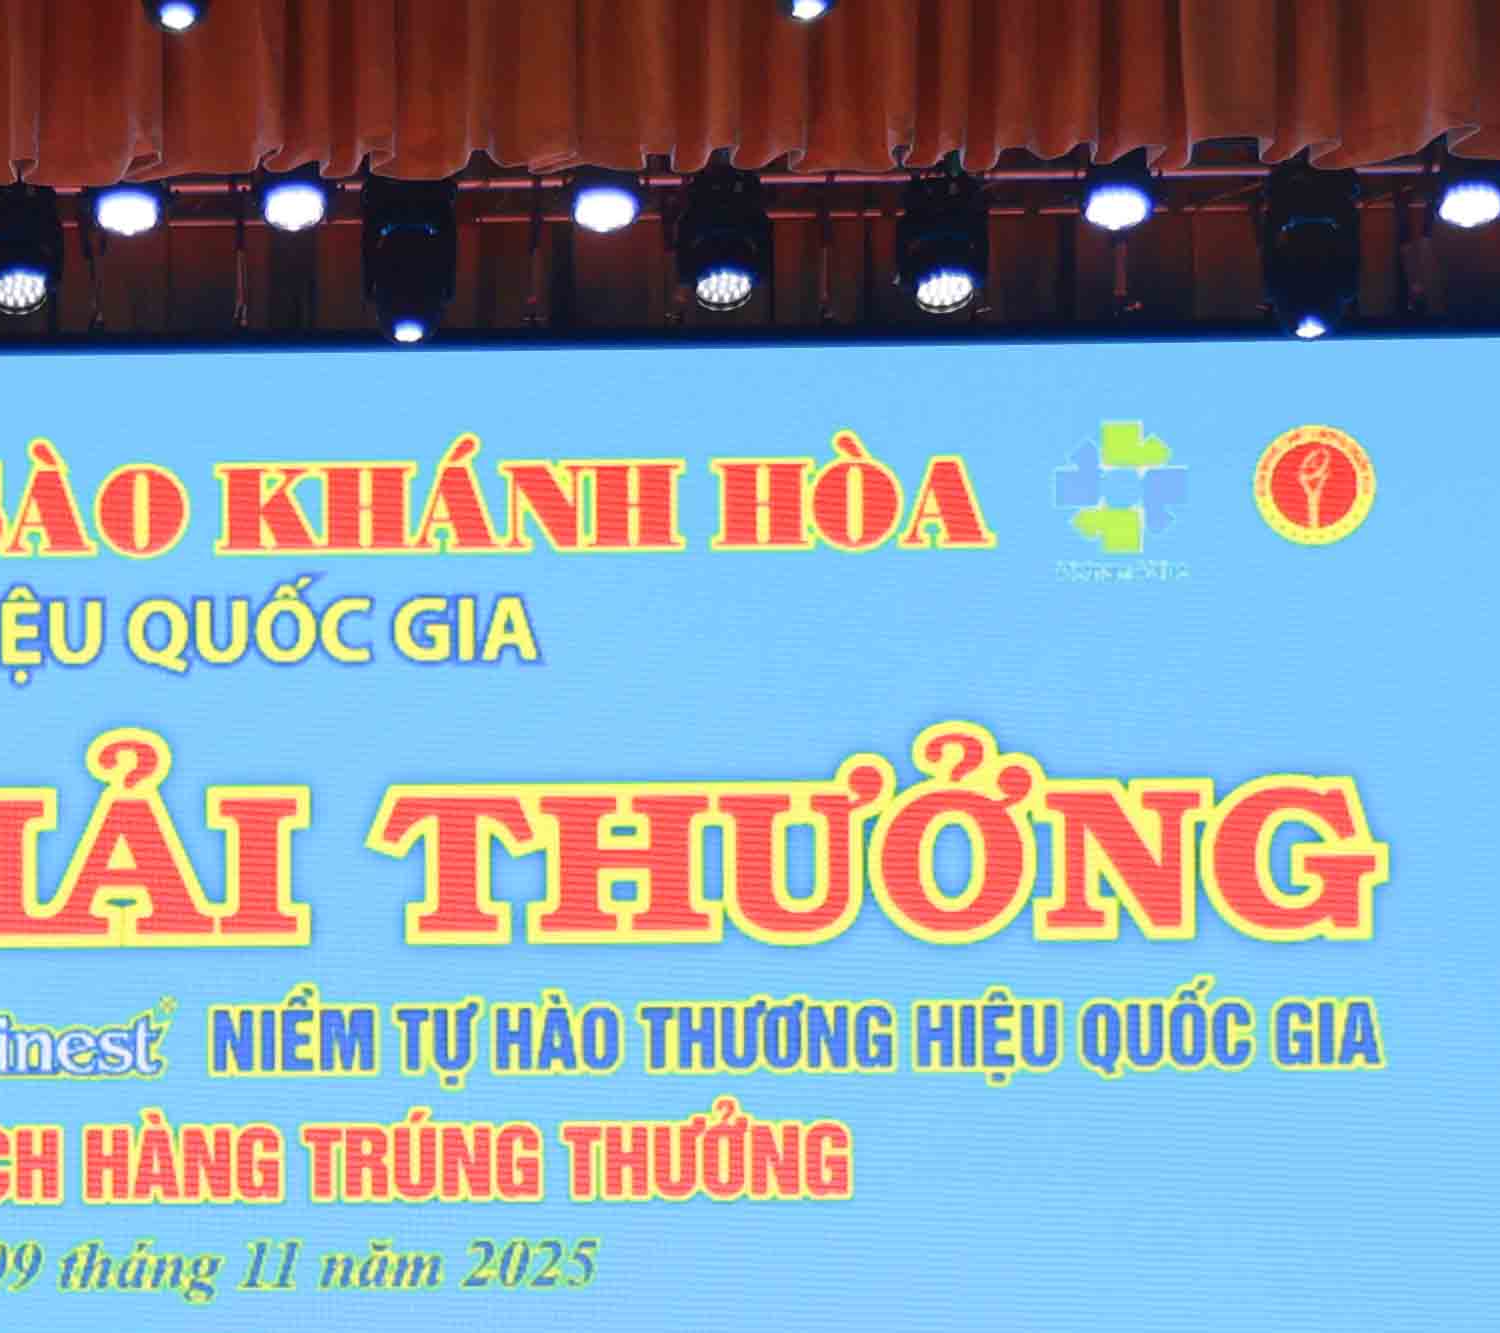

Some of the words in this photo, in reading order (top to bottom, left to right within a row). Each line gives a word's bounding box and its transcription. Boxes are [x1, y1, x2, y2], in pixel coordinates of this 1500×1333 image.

[212, 432, 688, 557] KHÁNH
[708, 428, 999, 554] HÒA
[126, 574, 374, 673] QUỐC
[391, 594, 541, 664] GIA
[364, 720, 1391, 948] THƯỞNG
[206, 982, 380, 1077] NIỀM
[391, 995, 483, 1092] TỰ
[490, 987, 625, 1077] HÀO
[635, 994, 898, 1076] THƯƠNG
[910, 984, 1065, 1088] HIỆU
[1075, 972, 1257, 1081] QUỐC
[1267, 996, 1386, 1071] GIA
[80, 1105, 286, 1206] HÀNG
[299, 1105, 546, 1205] TRÚNG
[557, 1094, 854, 1204] THƯỞNG
[58, 1238, 226, 1305] tháng
[238, 1239, 302, 1292] 11
[319, 1239, 445, 1291] năm
[461, 1237, 600, 1289] 2025
